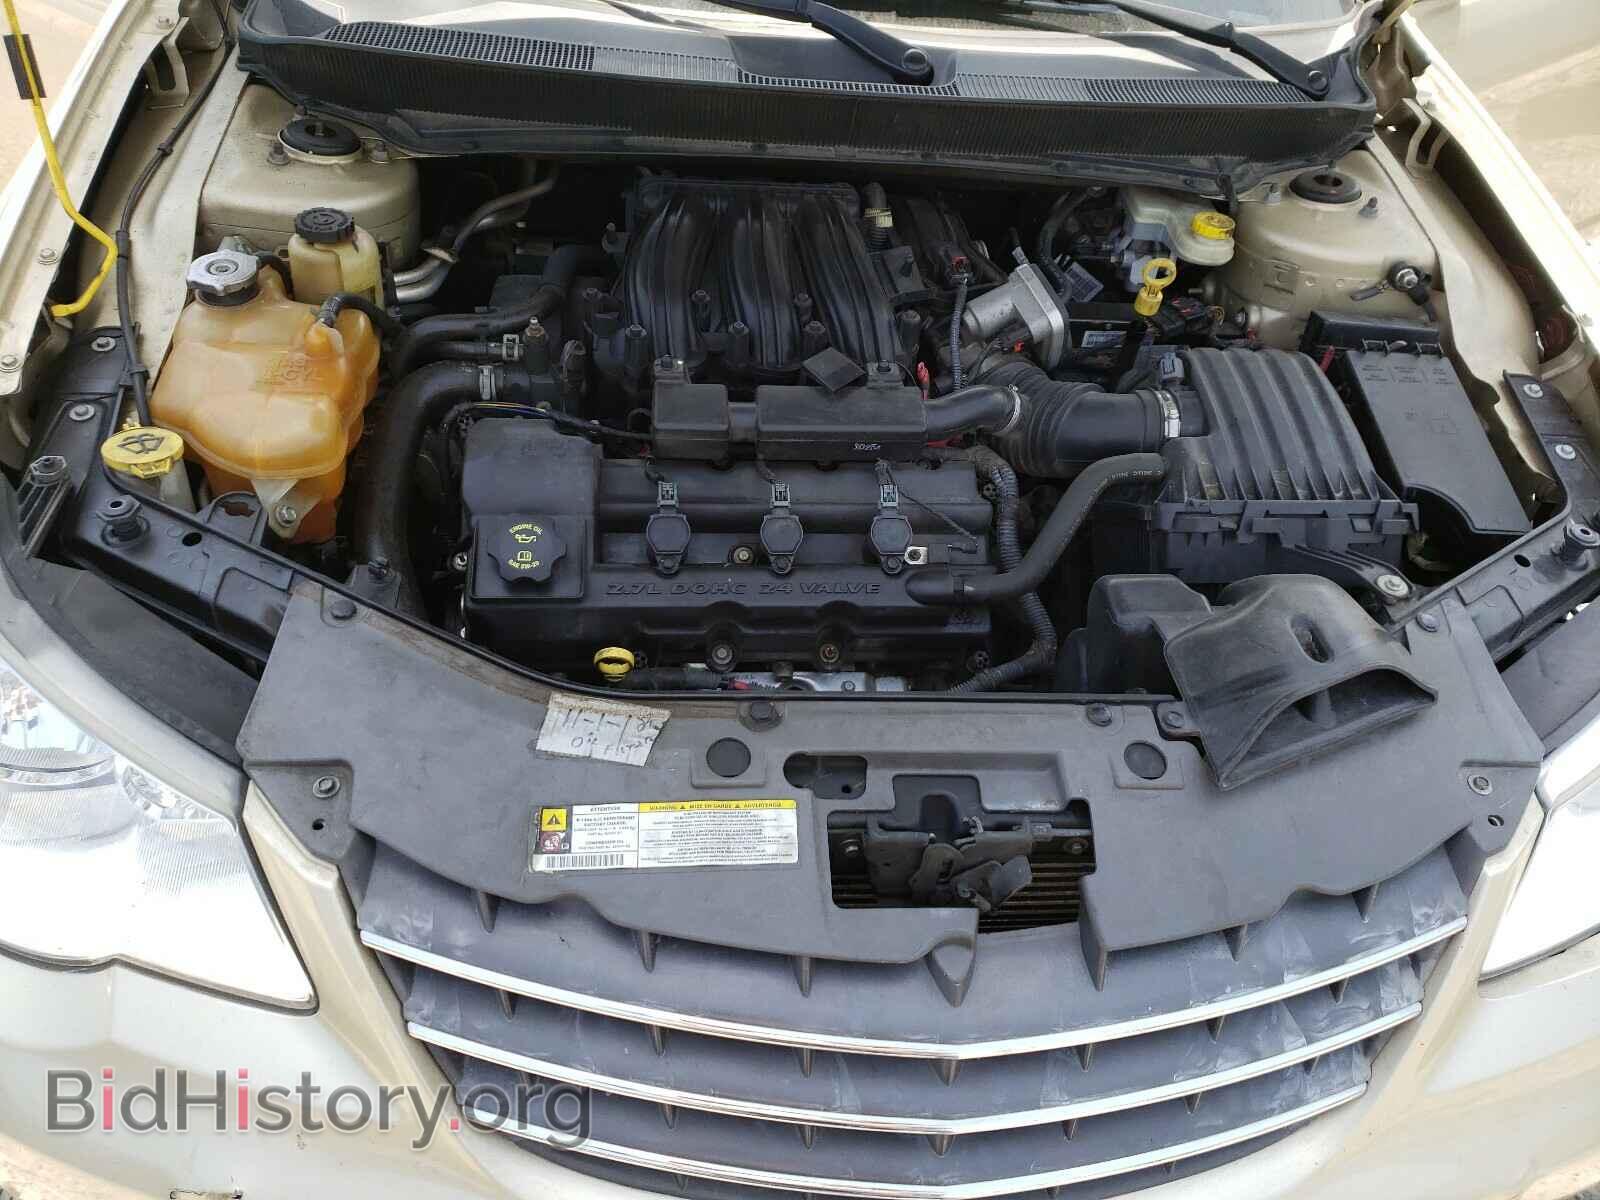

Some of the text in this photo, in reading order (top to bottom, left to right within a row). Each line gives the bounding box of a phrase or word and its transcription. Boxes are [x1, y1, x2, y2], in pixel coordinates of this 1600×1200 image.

[509, 523, 543, 535] ENGINE OIL
[607, 582, 881, 596] 2.7L DOHC 24 VALVE
